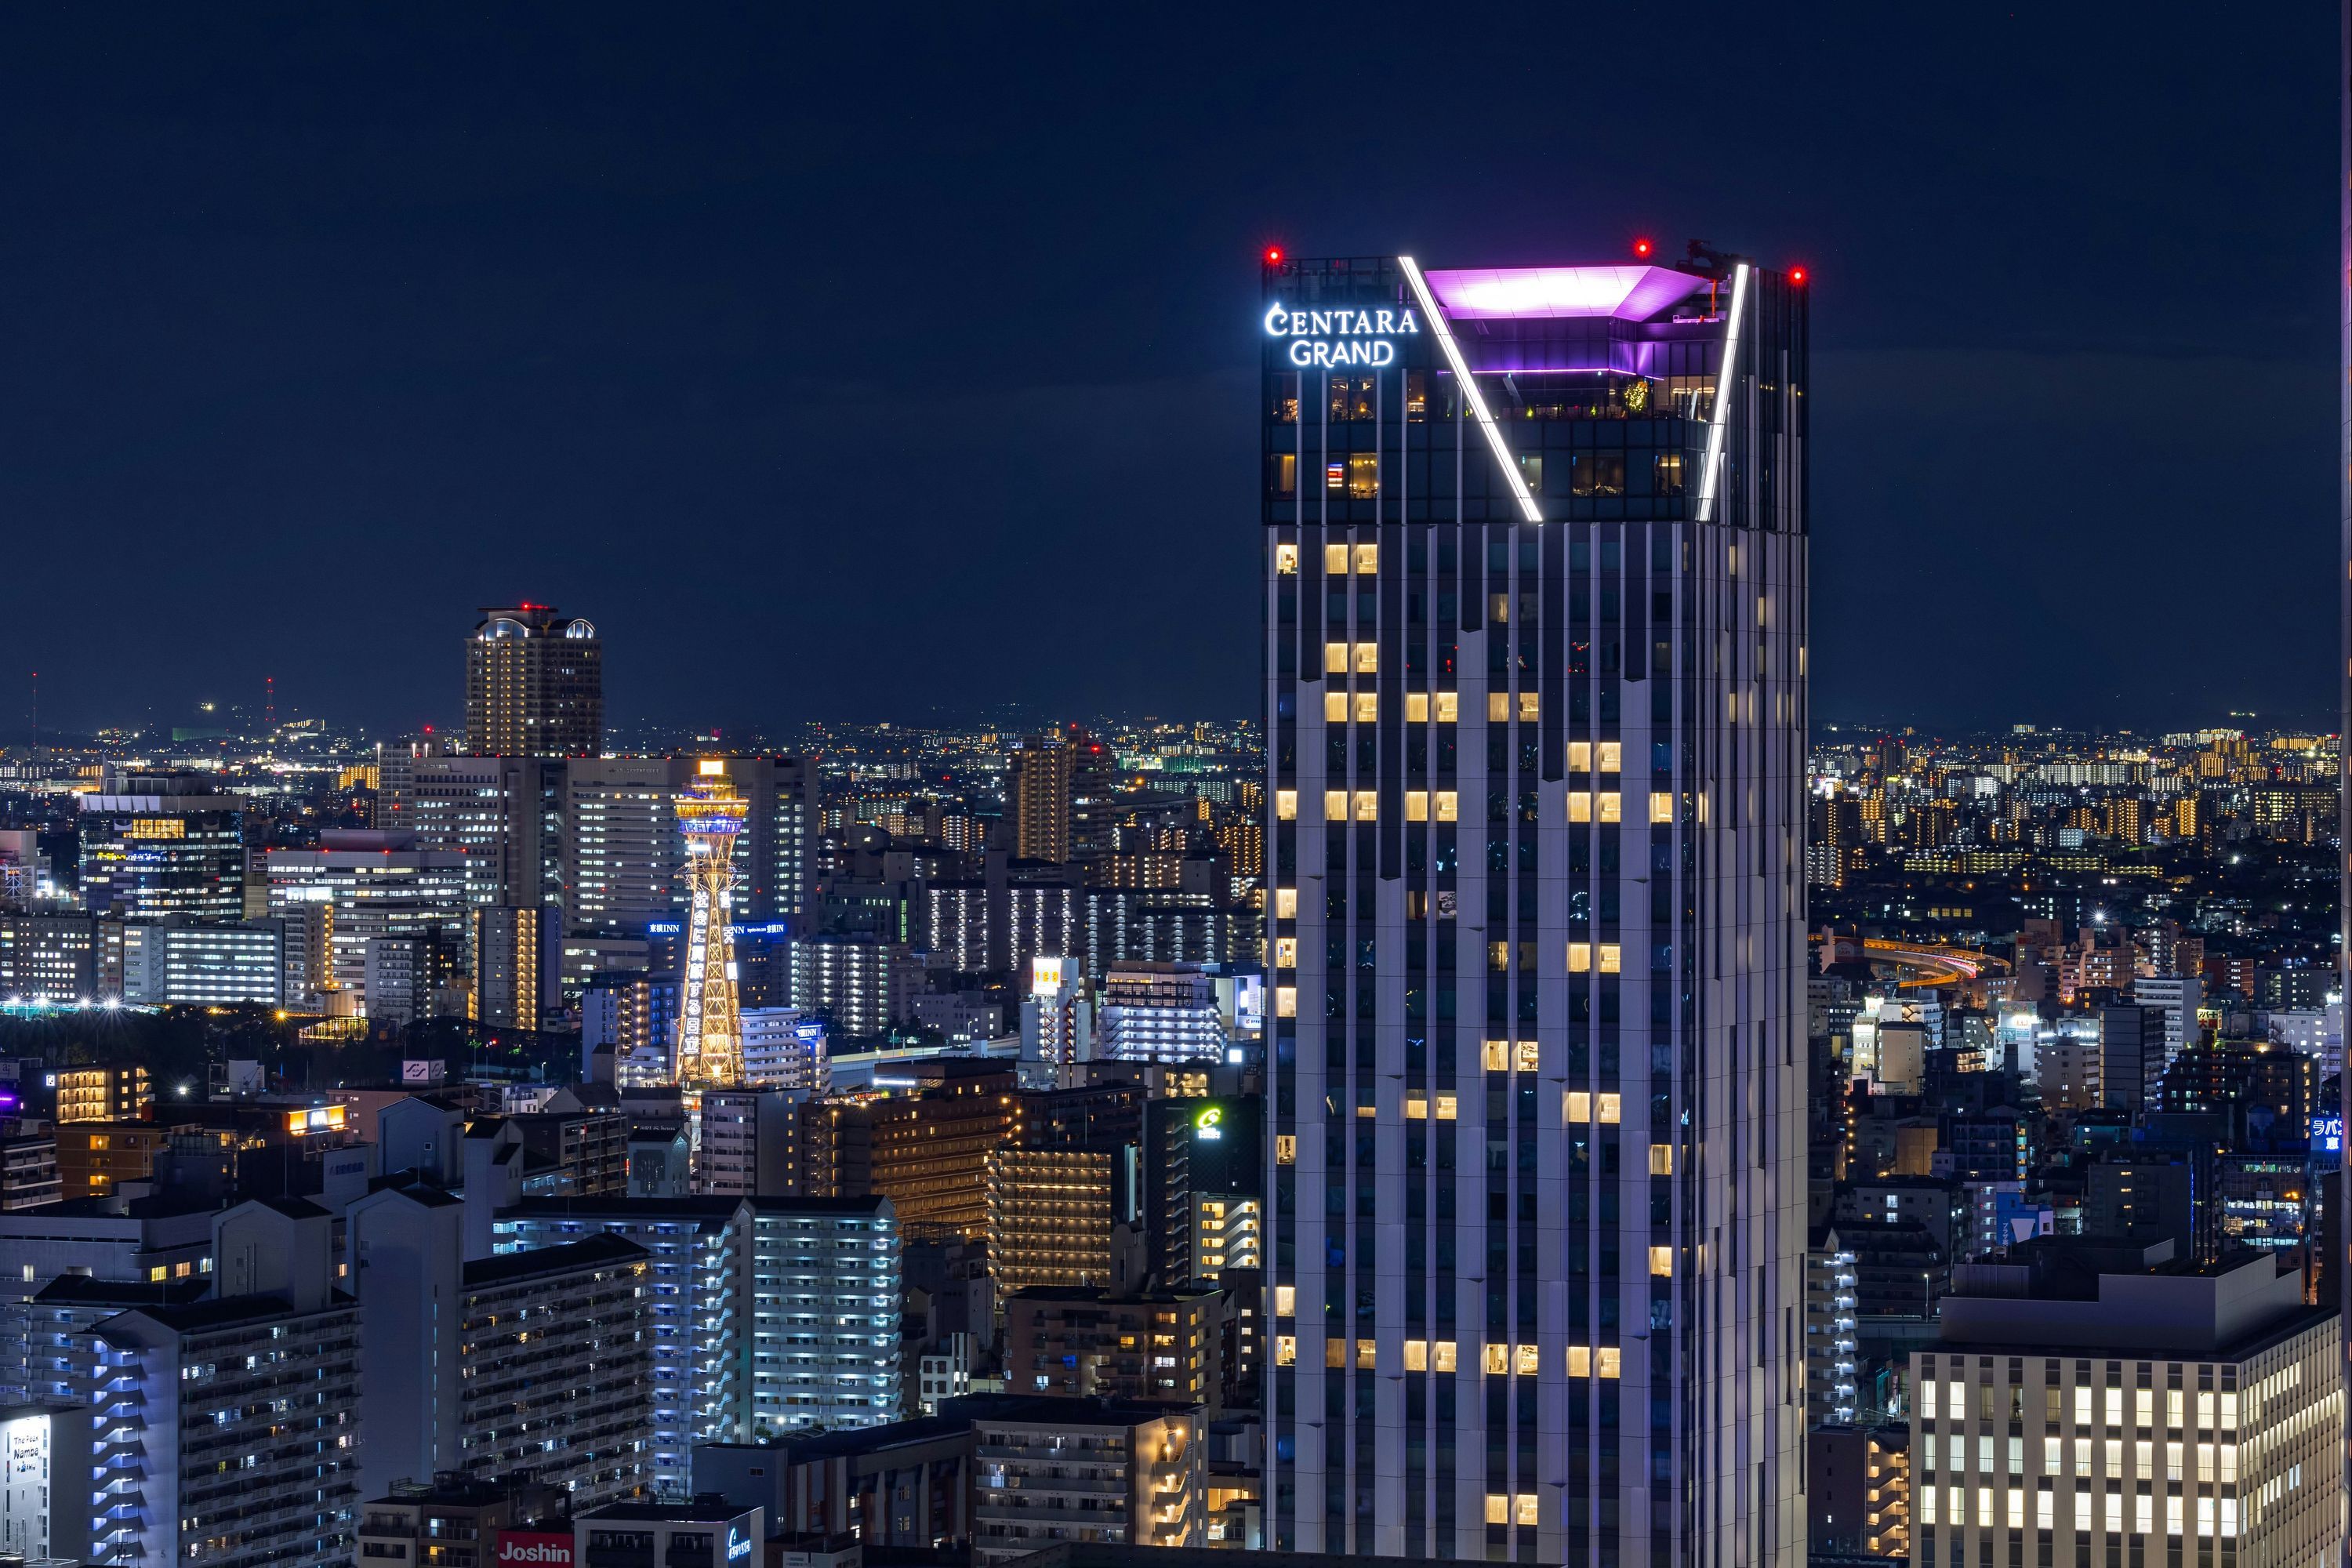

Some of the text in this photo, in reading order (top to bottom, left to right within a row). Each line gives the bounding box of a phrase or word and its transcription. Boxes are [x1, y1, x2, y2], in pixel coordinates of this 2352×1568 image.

[1265, 302, 1418, 336] CENTARA
[1290, 339, 1393, 368] GRAND
[650, 924, 680, 933] 東横INN
[14, 1447, 39, 1461] Namba
[499, 1541, 571, 1563] Joshin
